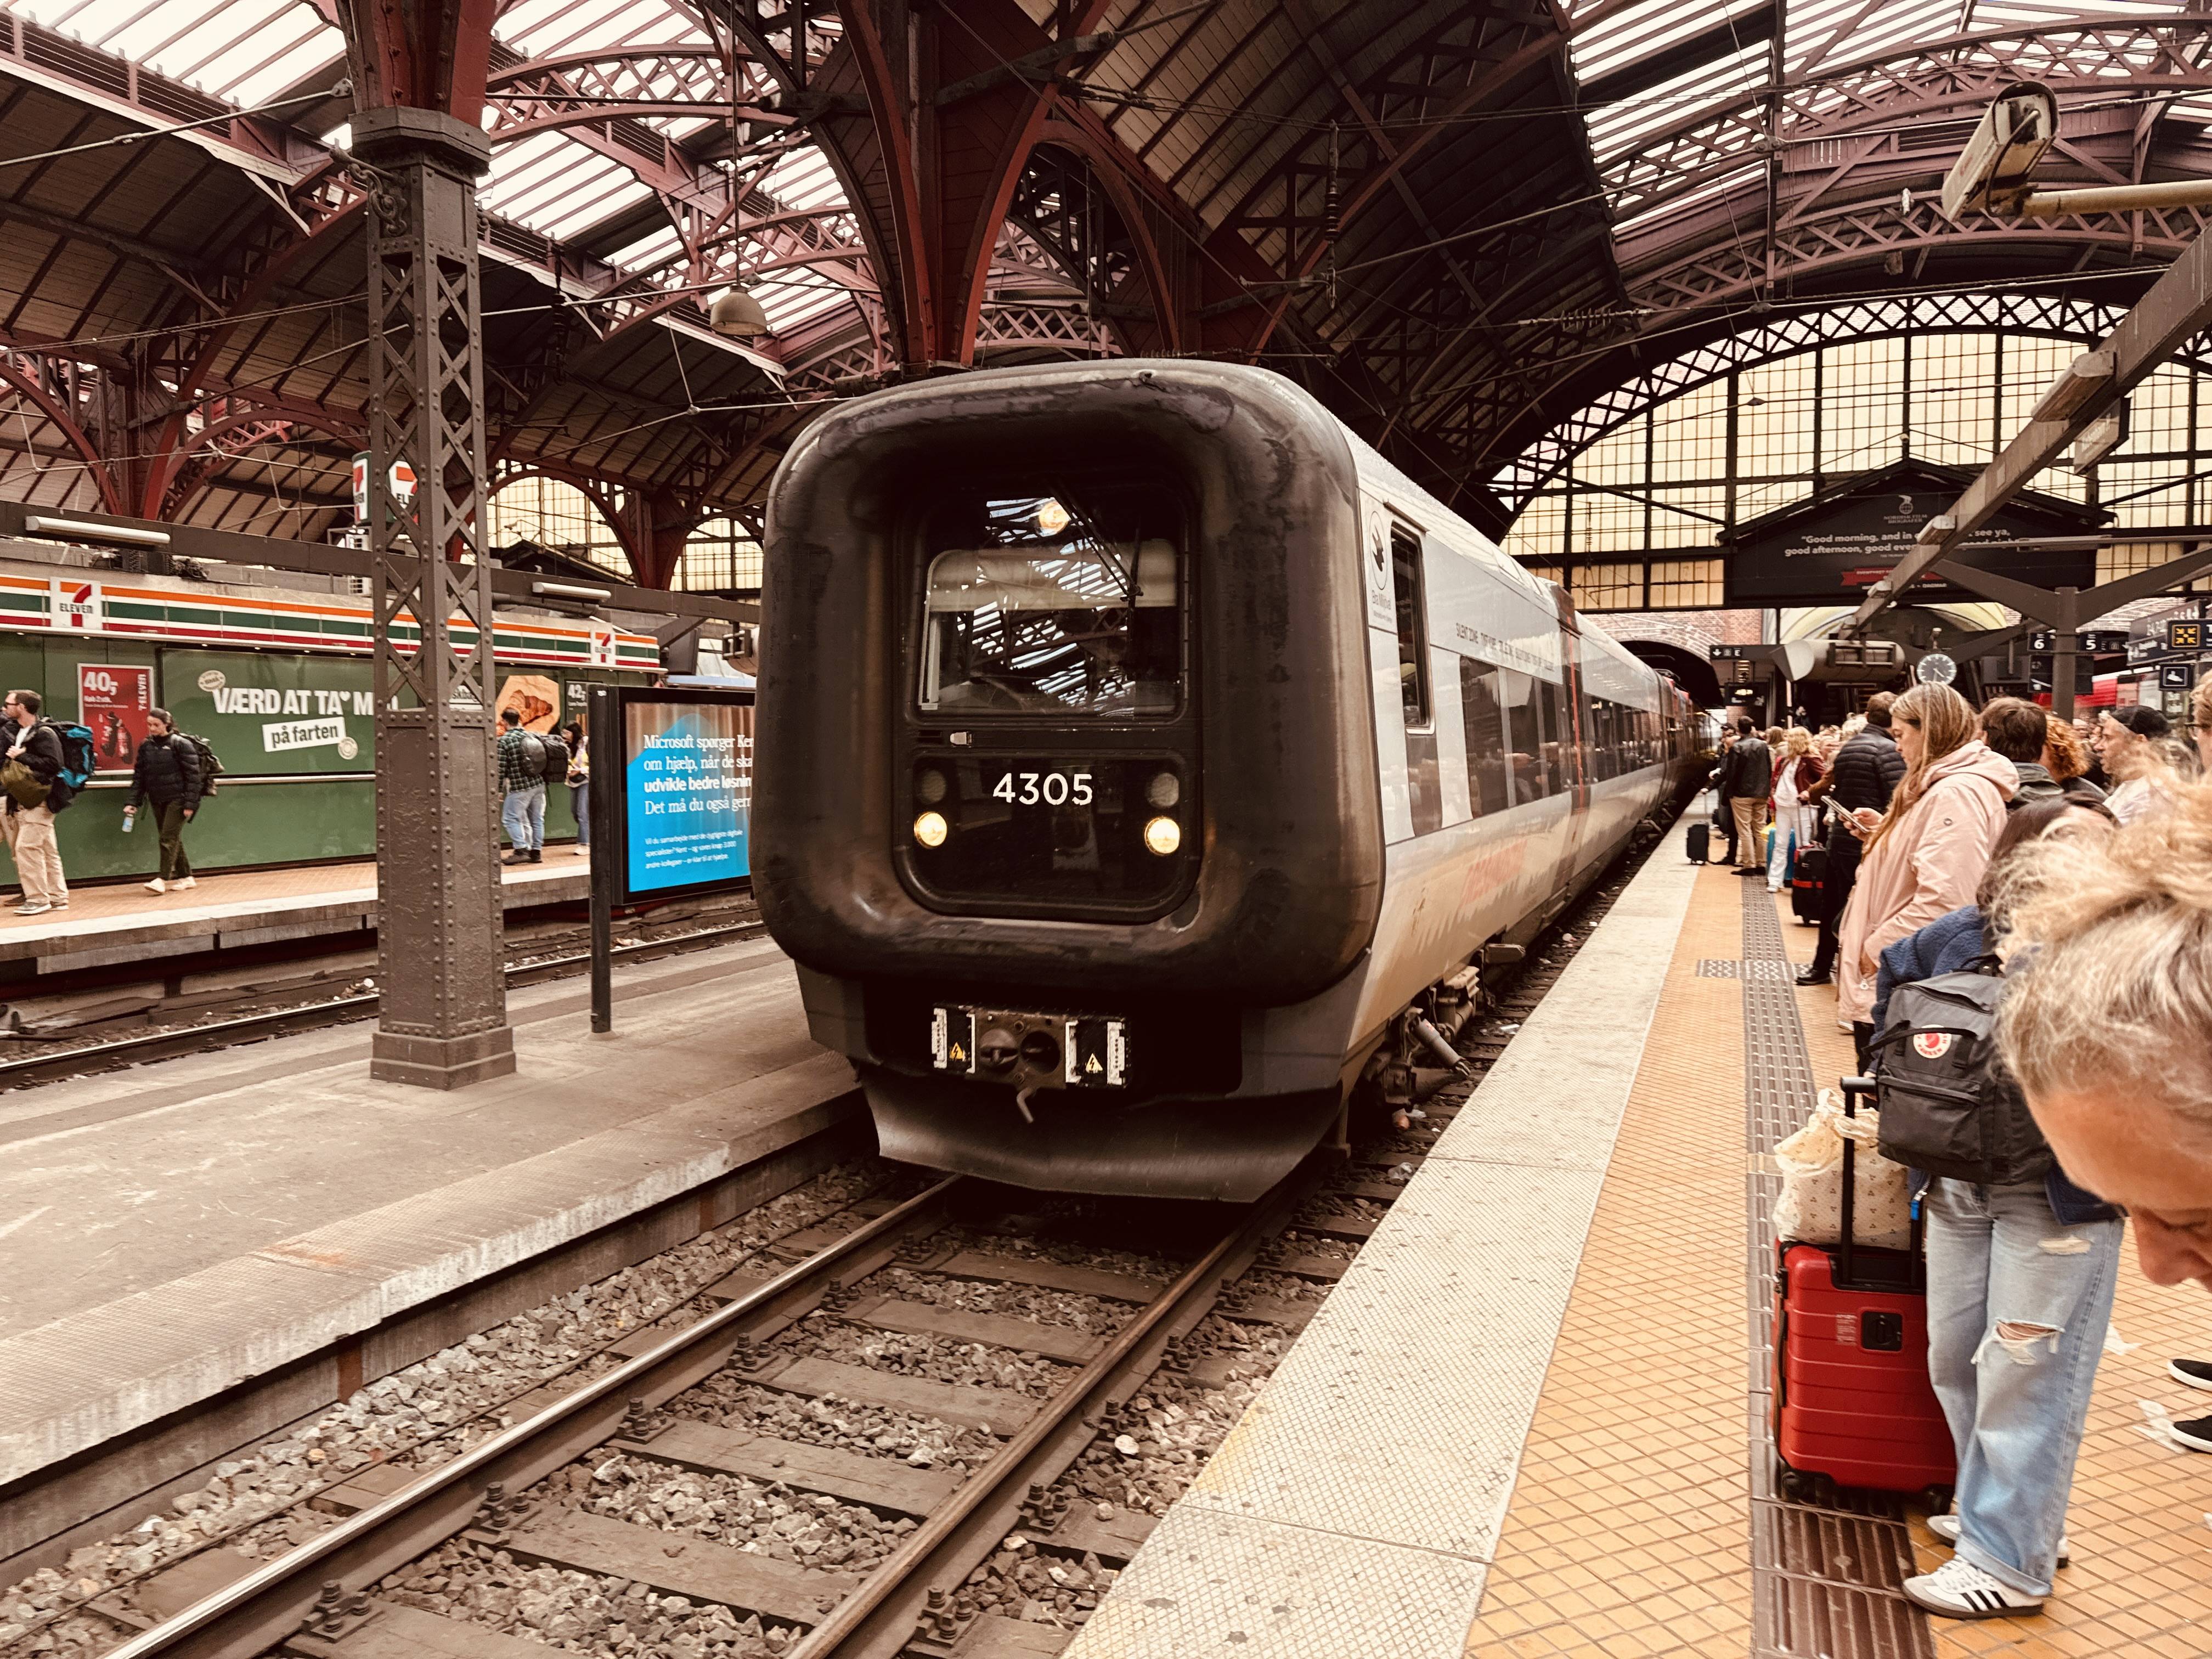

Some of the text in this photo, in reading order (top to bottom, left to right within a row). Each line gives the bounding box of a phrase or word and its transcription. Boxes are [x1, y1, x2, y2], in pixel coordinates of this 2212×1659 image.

[1835, 533, 1879, 543] morning,
[1881, 532, 1900, 540] and
[1785, 546, 1810, 557] good
[1812, 545, 1862, 554] afternoon,
[1865, 543, 1891, 554] good
[60, 581, 92, 627] 7
[2034, 639, 2045, 650] 6
[2086, 639, 2096, 650] 5
[213, 687, 281, 714] VÆRD
[283, 689, 312, 715] AT
[271, 725, 338, 749] på farten
[644, 734, 695, 749] Microsoft
[697, 737, 735, 752] spørger
[644, 759, 663, 771] om
[665, 755, 698, 774] hjælp,
[701, 755, 720, 769] når
[722, 755, 735, 768] de
[644, 777, 687, 793] udvikle
[689, 776, 720, 791] bedre
[992, 772, 1093, 805] 4305
[645, 800, 665, 815] Det
[668, 798, 687, 813] må
[689, 798, 704, 812] du
[706, 795, 730, 813] også
